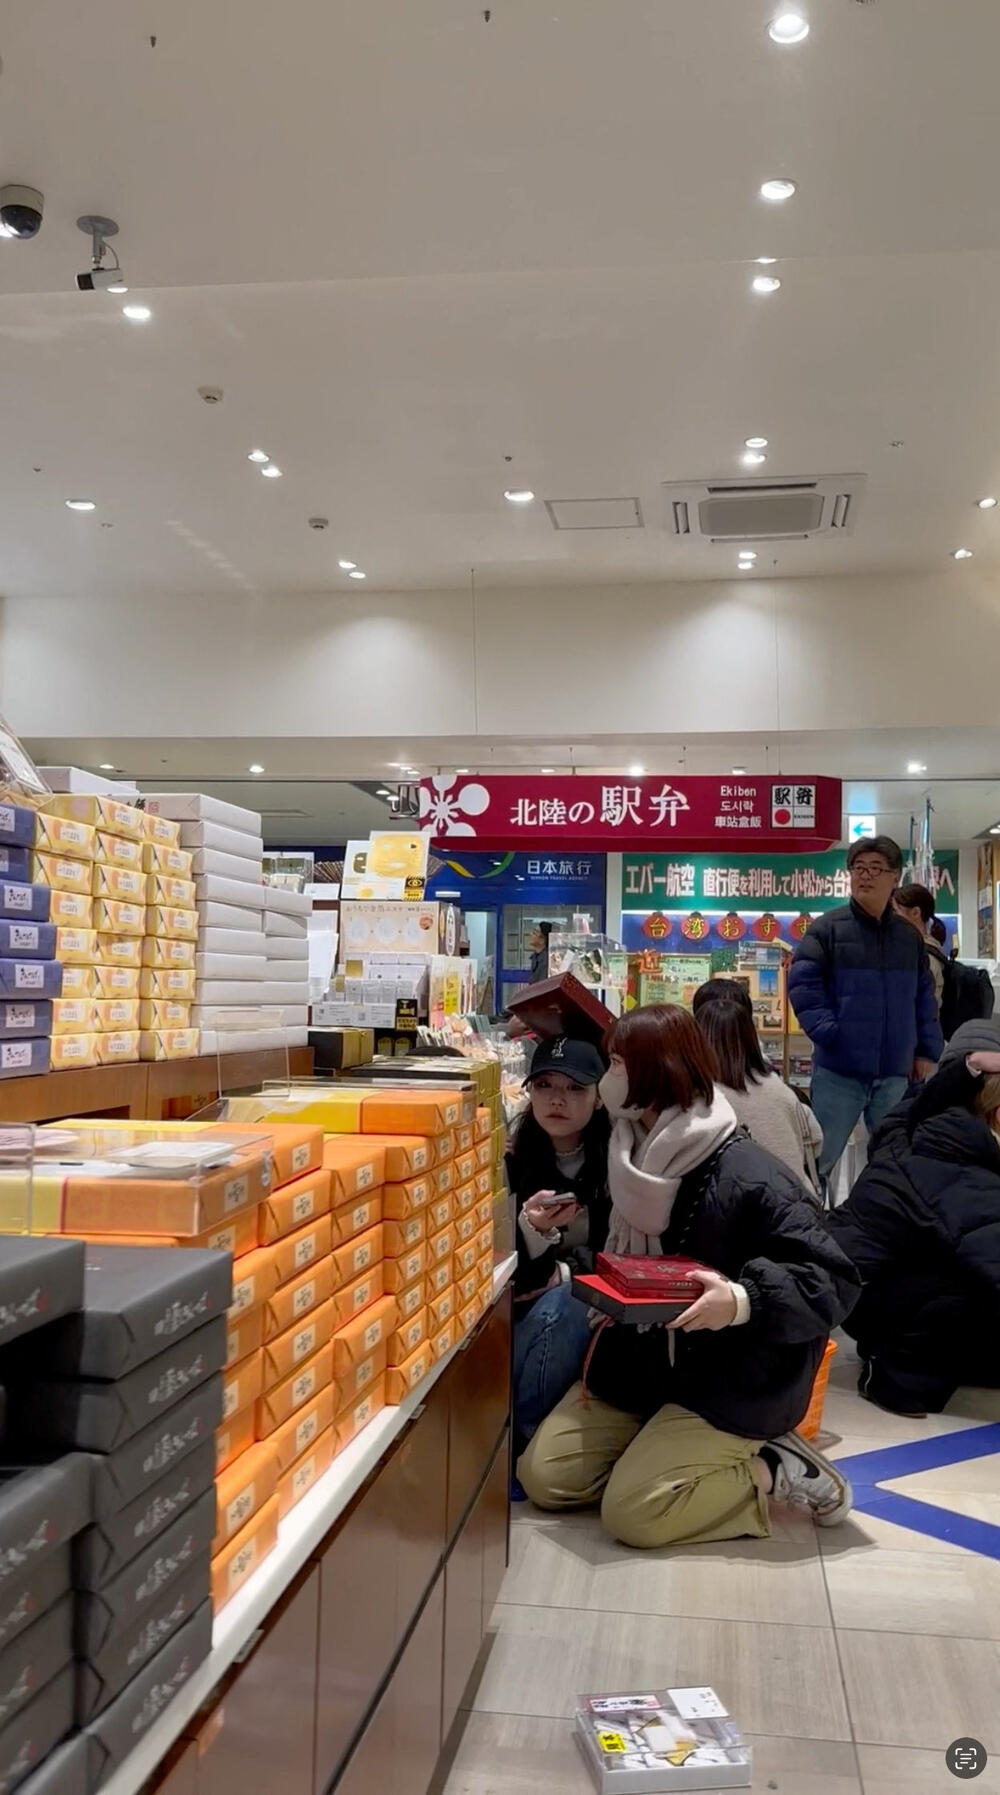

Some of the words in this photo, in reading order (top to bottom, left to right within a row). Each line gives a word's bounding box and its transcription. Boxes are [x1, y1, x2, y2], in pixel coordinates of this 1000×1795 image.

[720, 785, 757, 797] Ekiben
[510, 784, 690, 827] 北陸の駅弁
[720, 800, 754, 812] 도시락
[714, 815, 762, 828] 車站盒飯
[527, 860, 592, 875] 日本旅行
[625, 863, 695, 897] エバー航空
